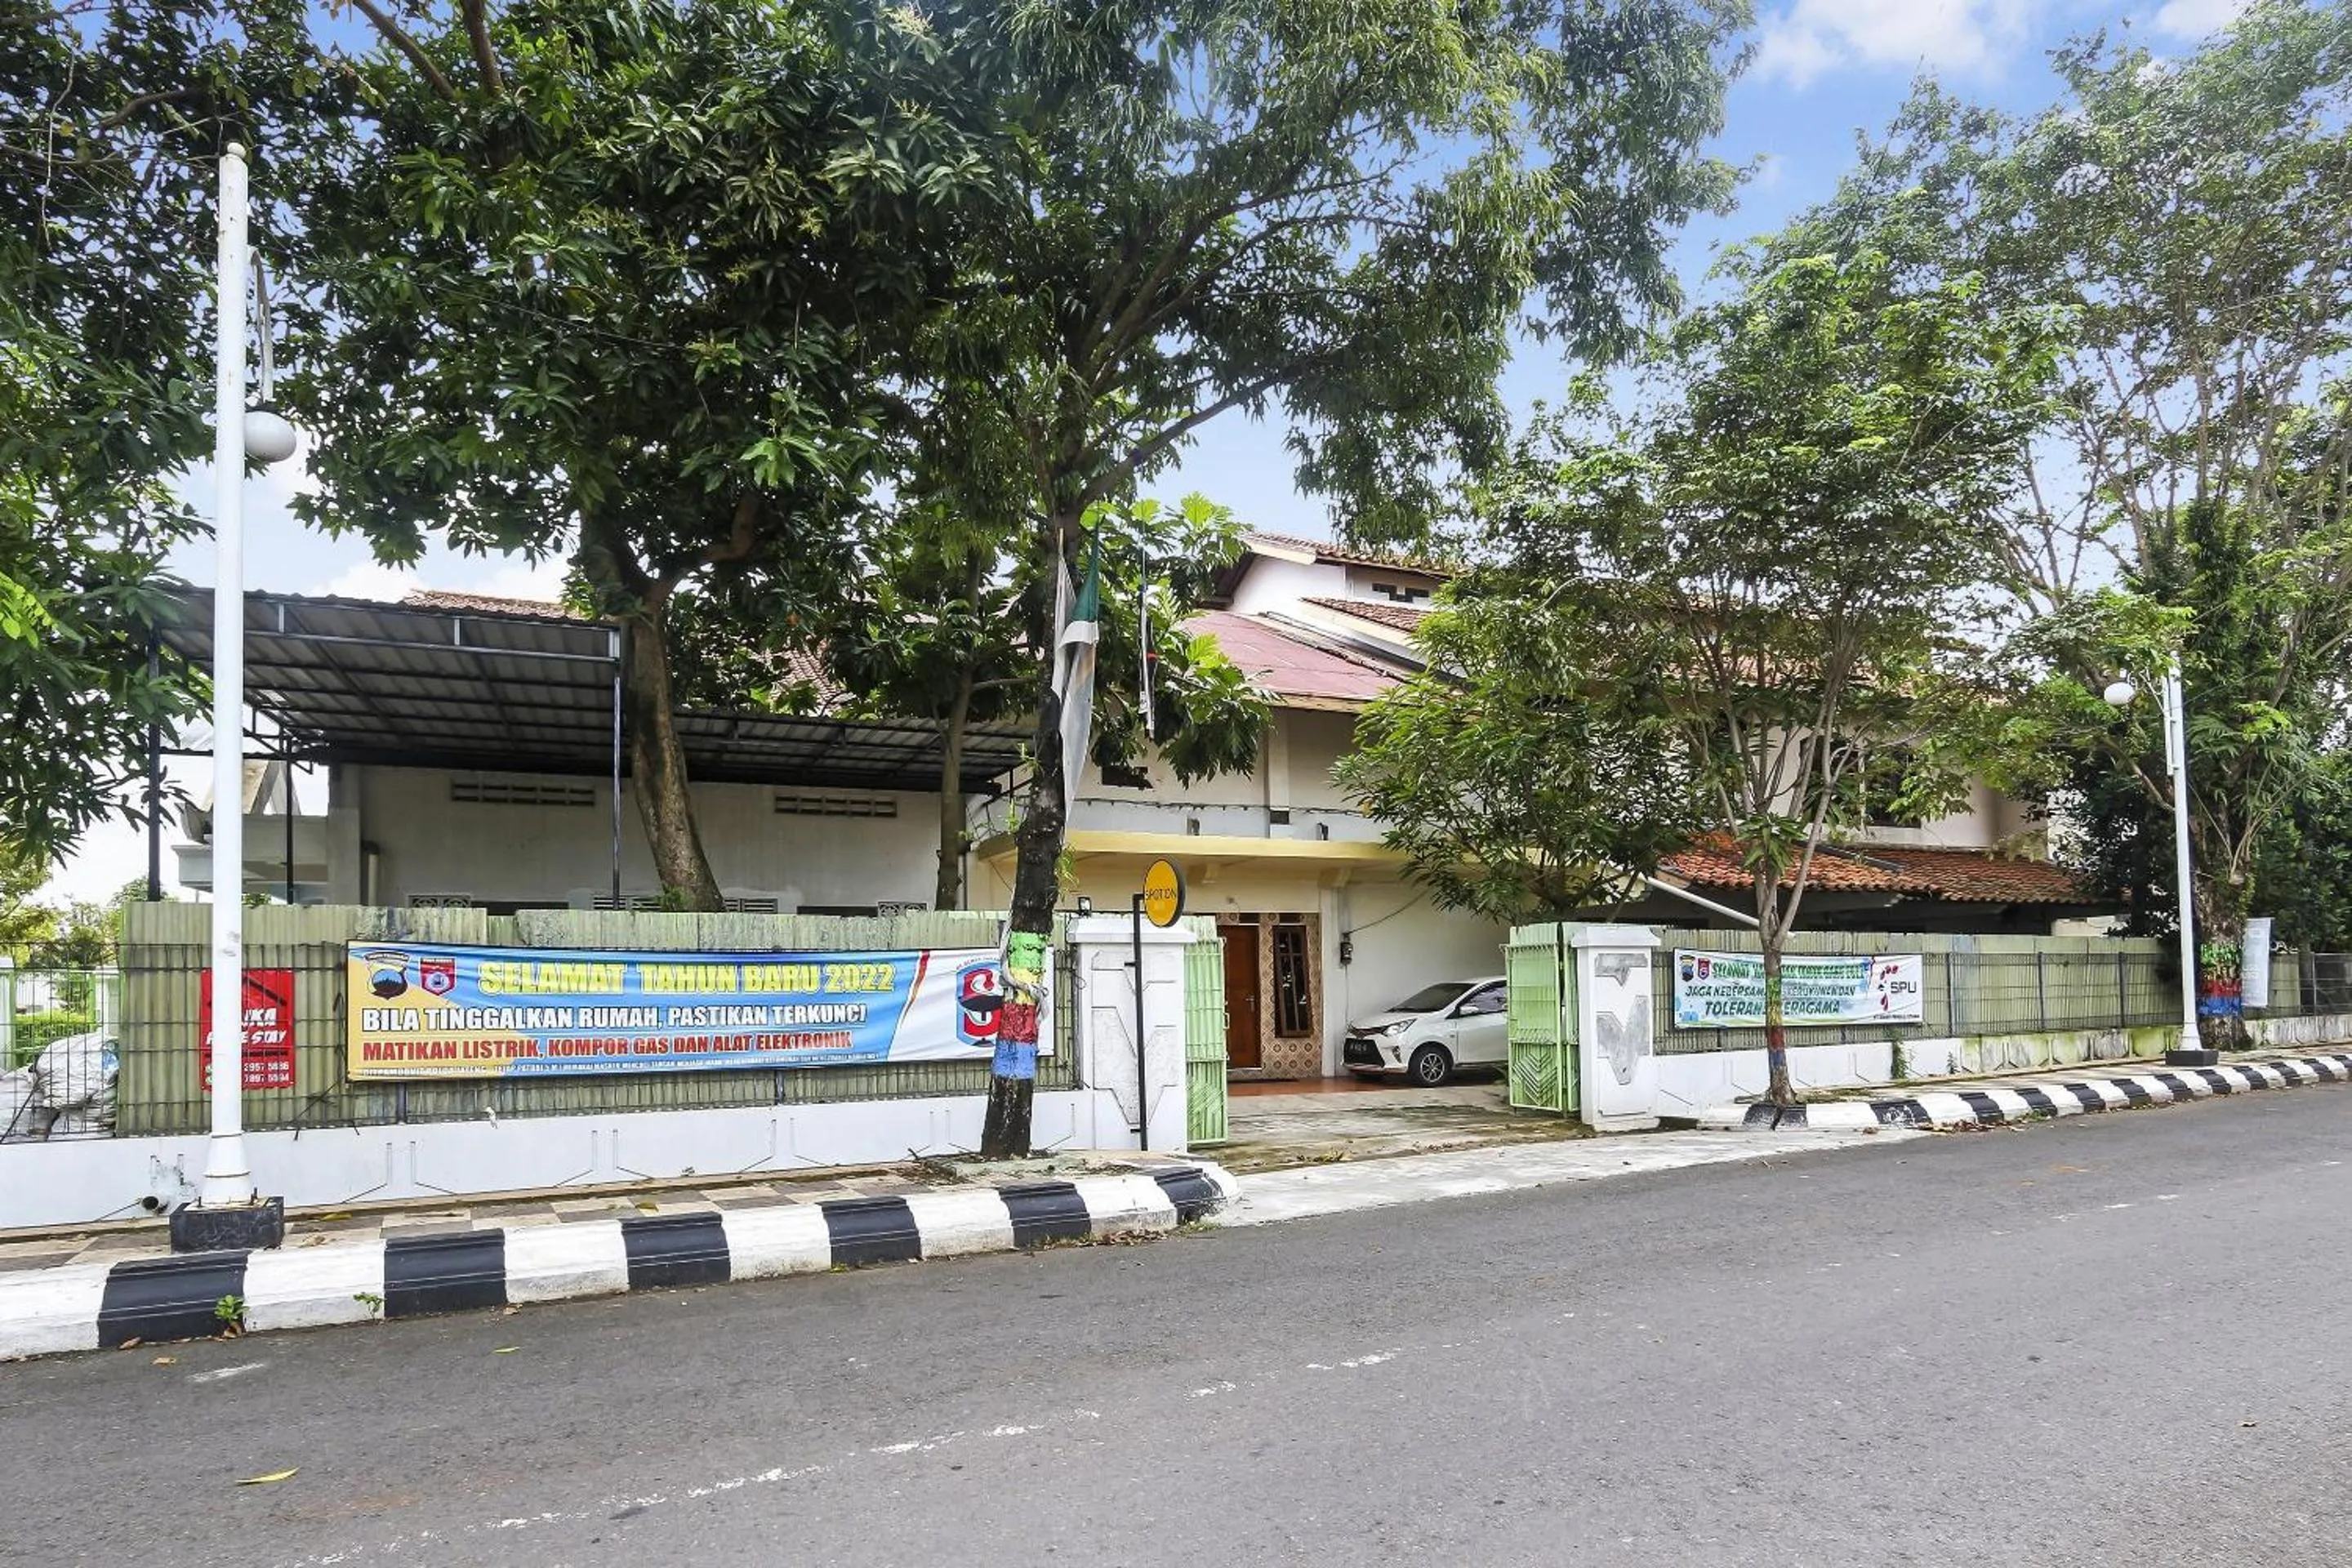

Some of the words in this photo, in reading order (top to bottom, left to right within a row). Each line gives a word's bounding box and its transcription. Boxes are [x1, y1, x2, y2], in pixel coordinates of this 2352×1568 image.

[478, 962, 627, 995] SELAMAT
[638, 962, 737, 994] TAHUN
[742, 962, 822, 993] BARU
[824, 962, 896, 993] 2022
[1891, 981, 1917, 994] SPU
[1685, 985, 1713, 996] JAGA
[362, 1008, 421, 1031] BILA
[424, 1006, 572, 1031] TINGGALKAN
[578, 1007, 663, 1029] RUMAH,
[667, 1004, 768, 1027] PASTIKAN
[771, 1003, 868, 1024] TERKUNCI
[1705, 1000, 1766, 1017] TOLERAN
[1784, 1000, 1840, 1015] ERAGAMA
[363, 1040, 457, 1061] MATIKAN
[462, 1038, 544, 1060] LISTRIK,
[548, 1037, 629, 1057] KOMPOR
[633, 1036, 669, 1055] GAS
[673, 1035, 709, 1053] DAN
[712, 1034, 752, 1052] ALAT
[755, 1031, 853, 1050] ELEKTRONIK
